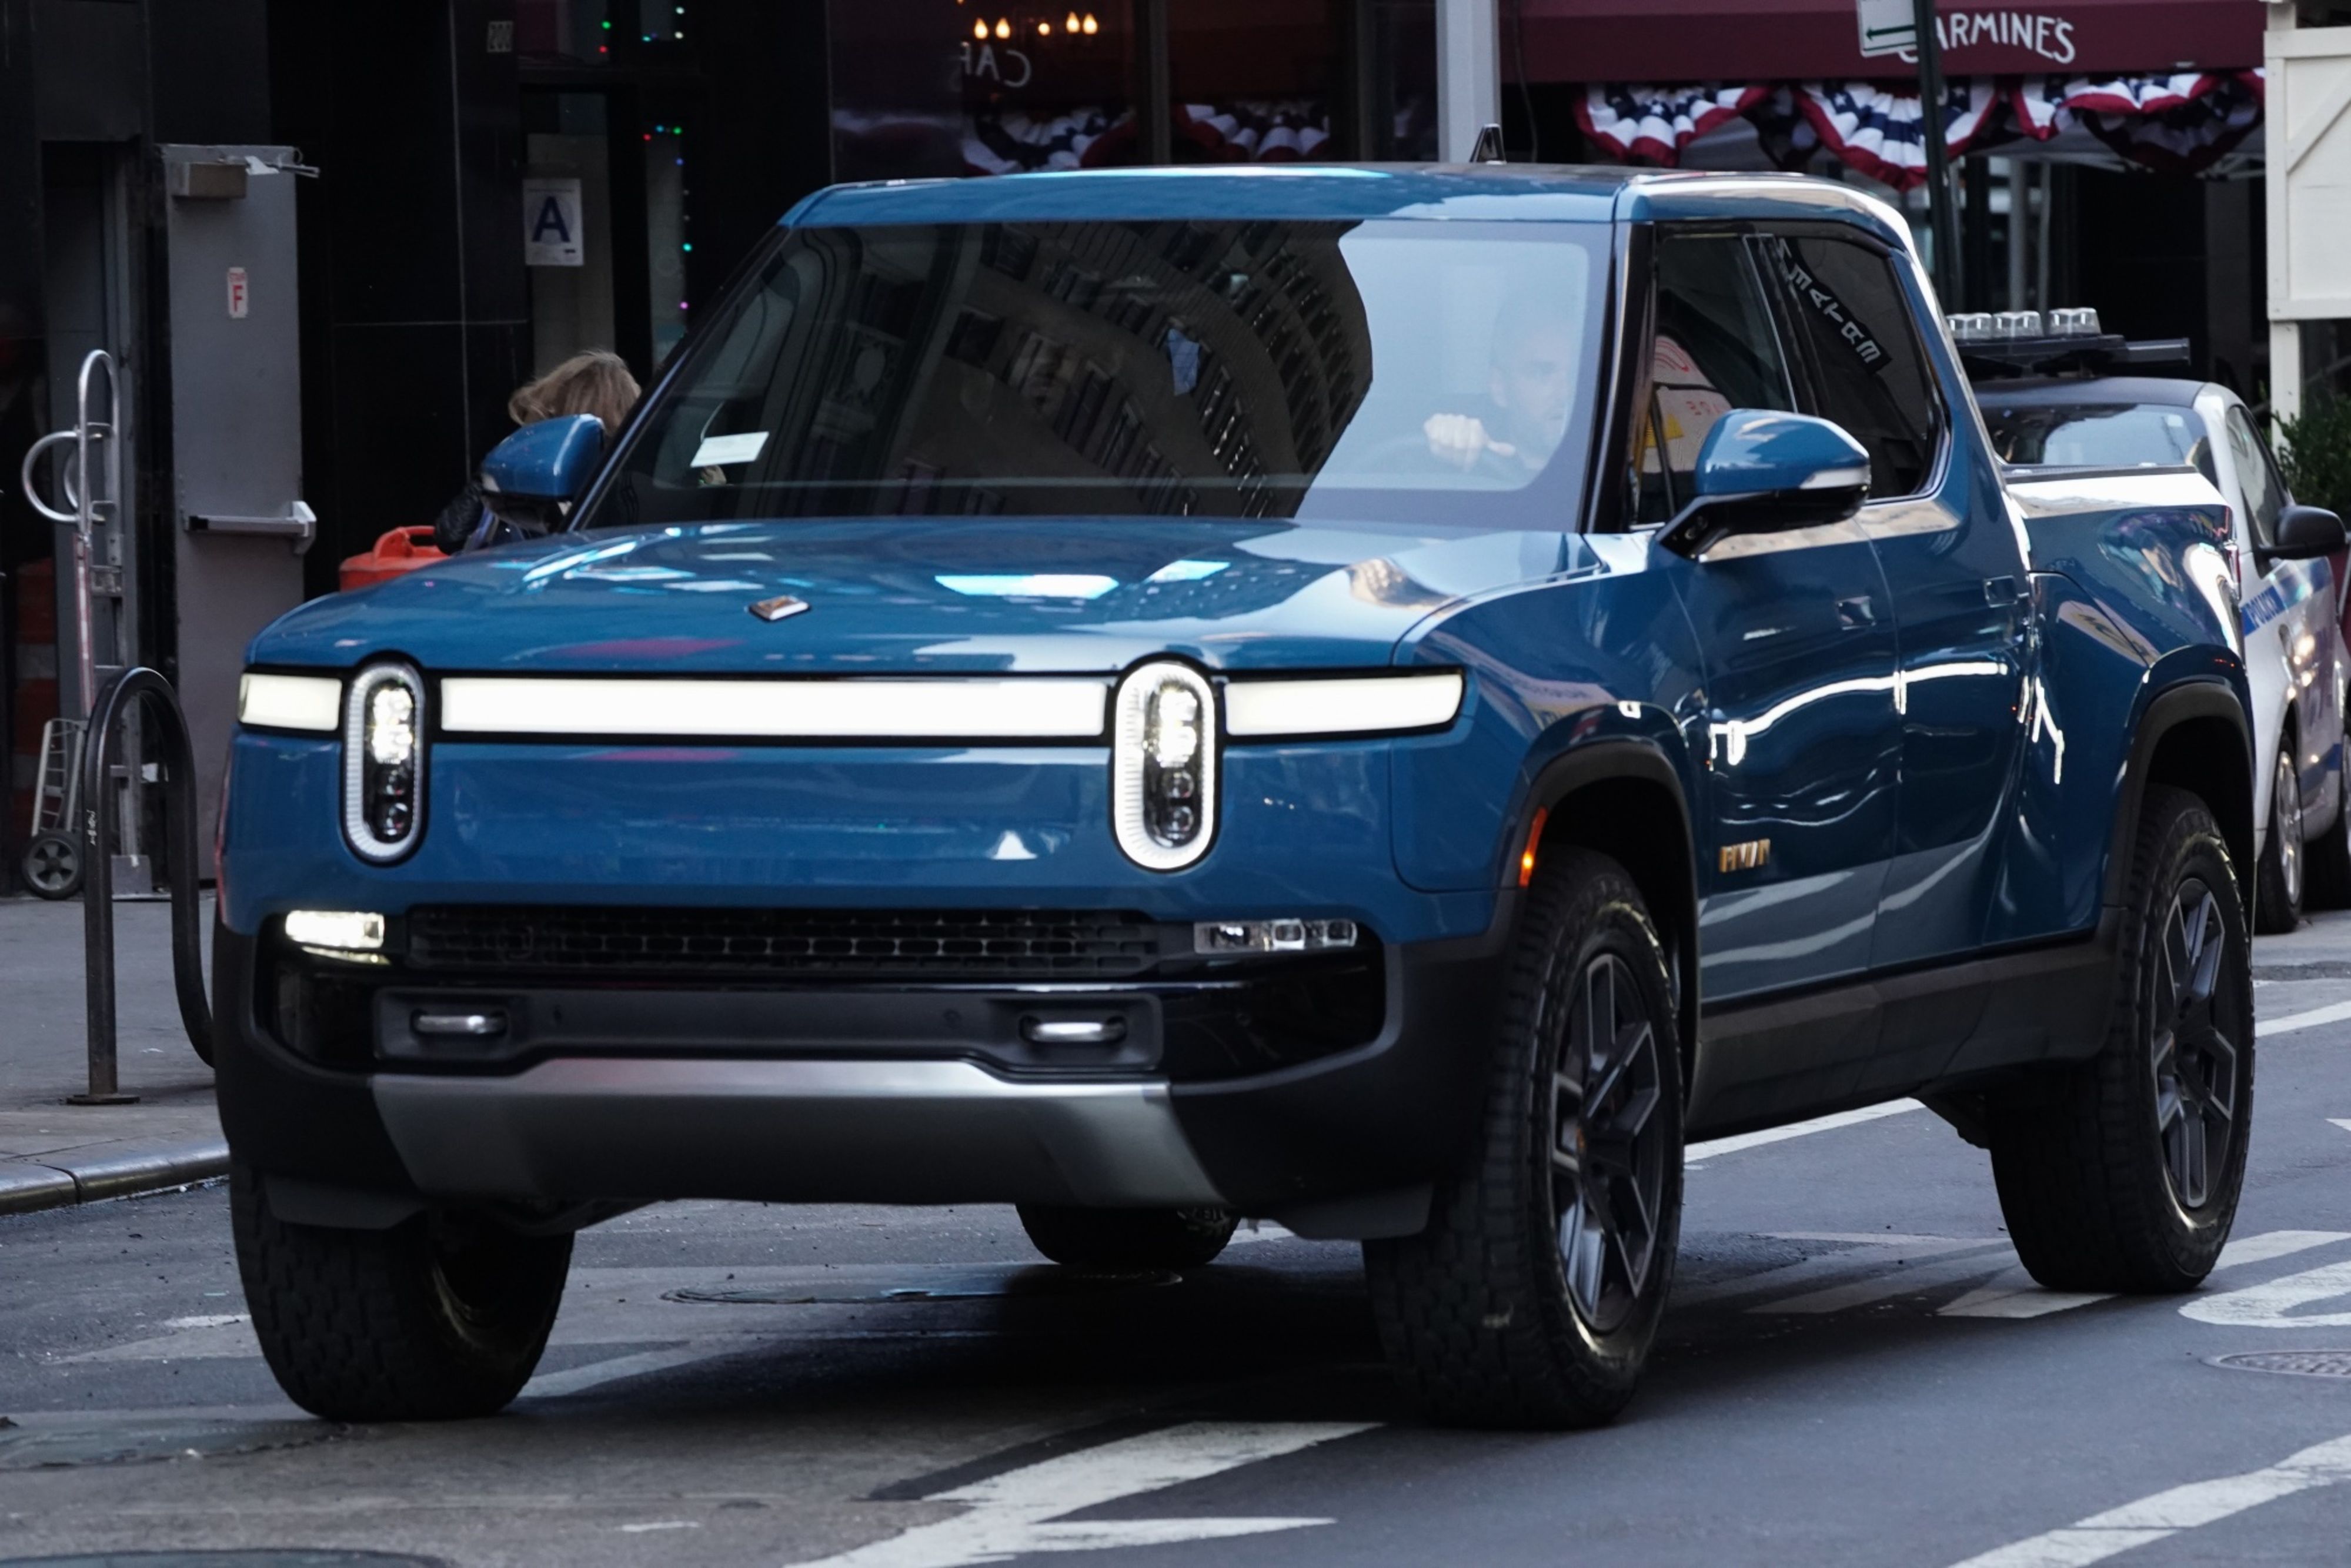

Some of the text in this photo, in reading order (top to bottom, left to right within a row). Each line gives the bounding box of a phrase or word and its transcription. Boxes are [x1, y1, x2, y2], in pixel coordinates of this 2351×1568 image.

[1899, 11, 2076, 64] RMINE'S
[532, 196, 570, 242] A
[233, 285, 243, 312] F
